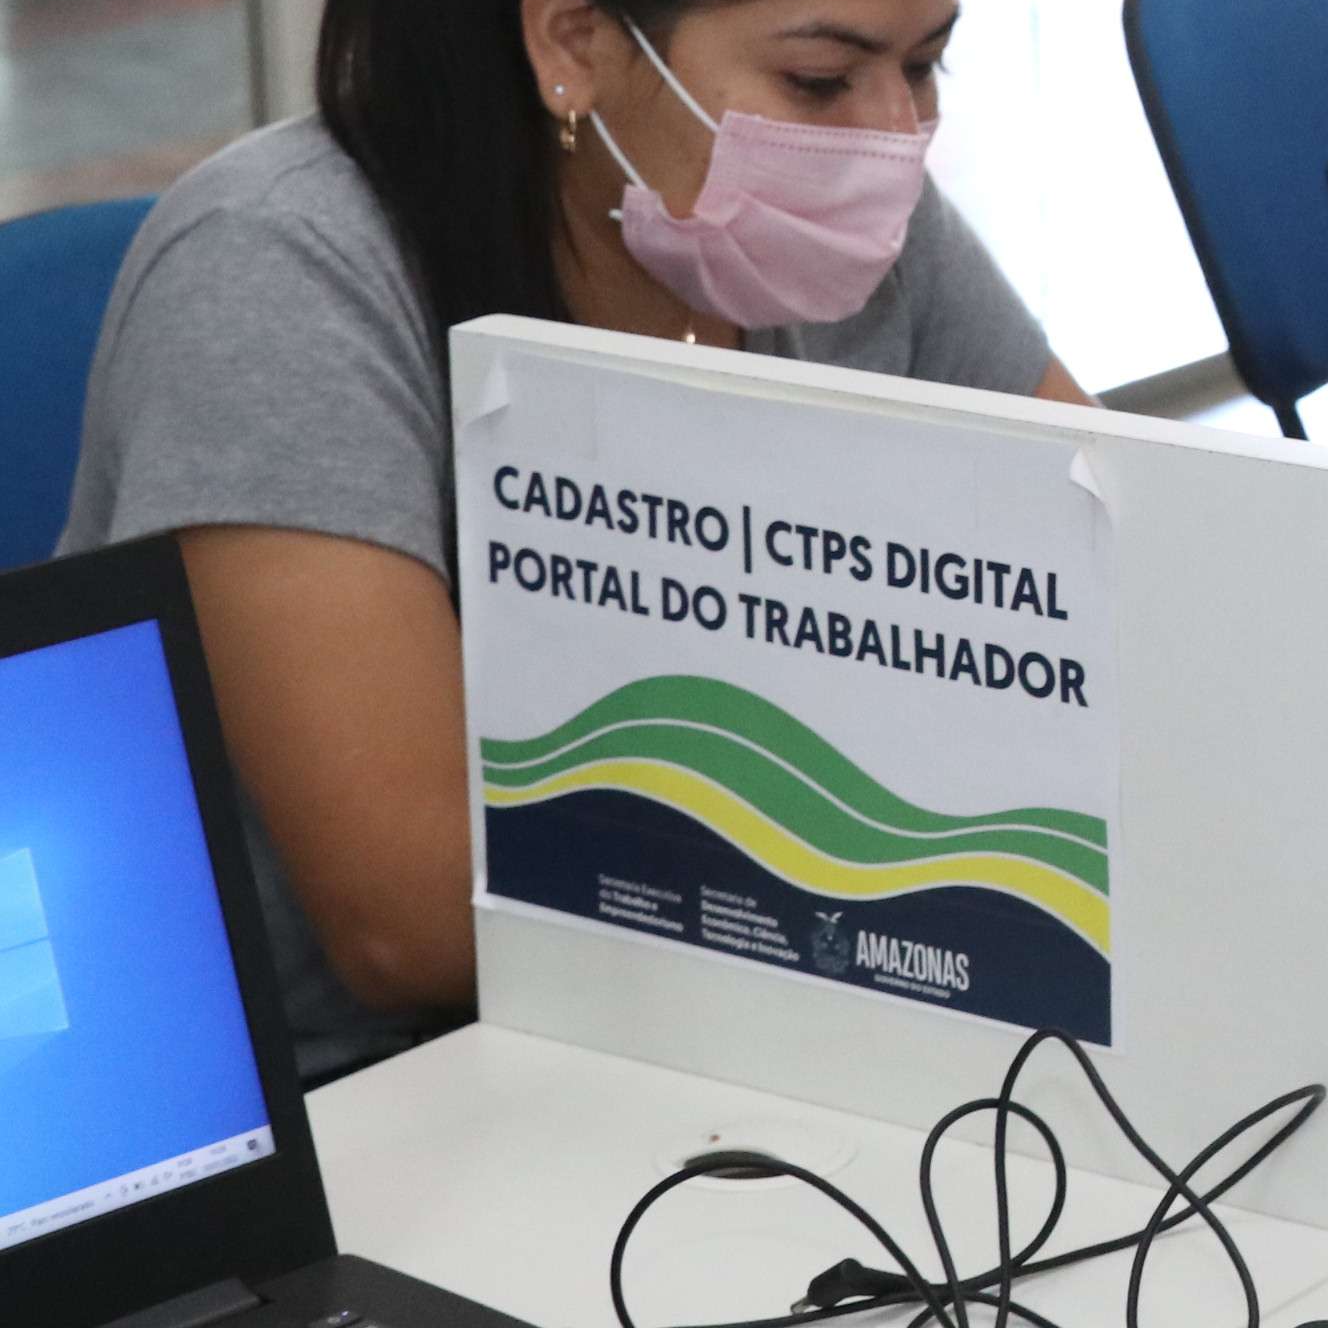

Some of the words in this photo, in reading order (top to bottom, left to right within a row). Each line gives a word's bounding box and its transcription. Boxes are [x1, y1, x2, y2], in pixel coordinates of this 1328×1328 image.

[493, 465, 730, 552] CADASTRO
[765, 519, 873, 582] CTPS
[887, 541, 1069, 621] DIGITAL
[489, 540, 650, 617] PORTAL
[661, 576, 728, 631] DO
[738, 592, 1090, 708] TRABALHADOR
[856, 930, 970, 992] AMAZONAS
